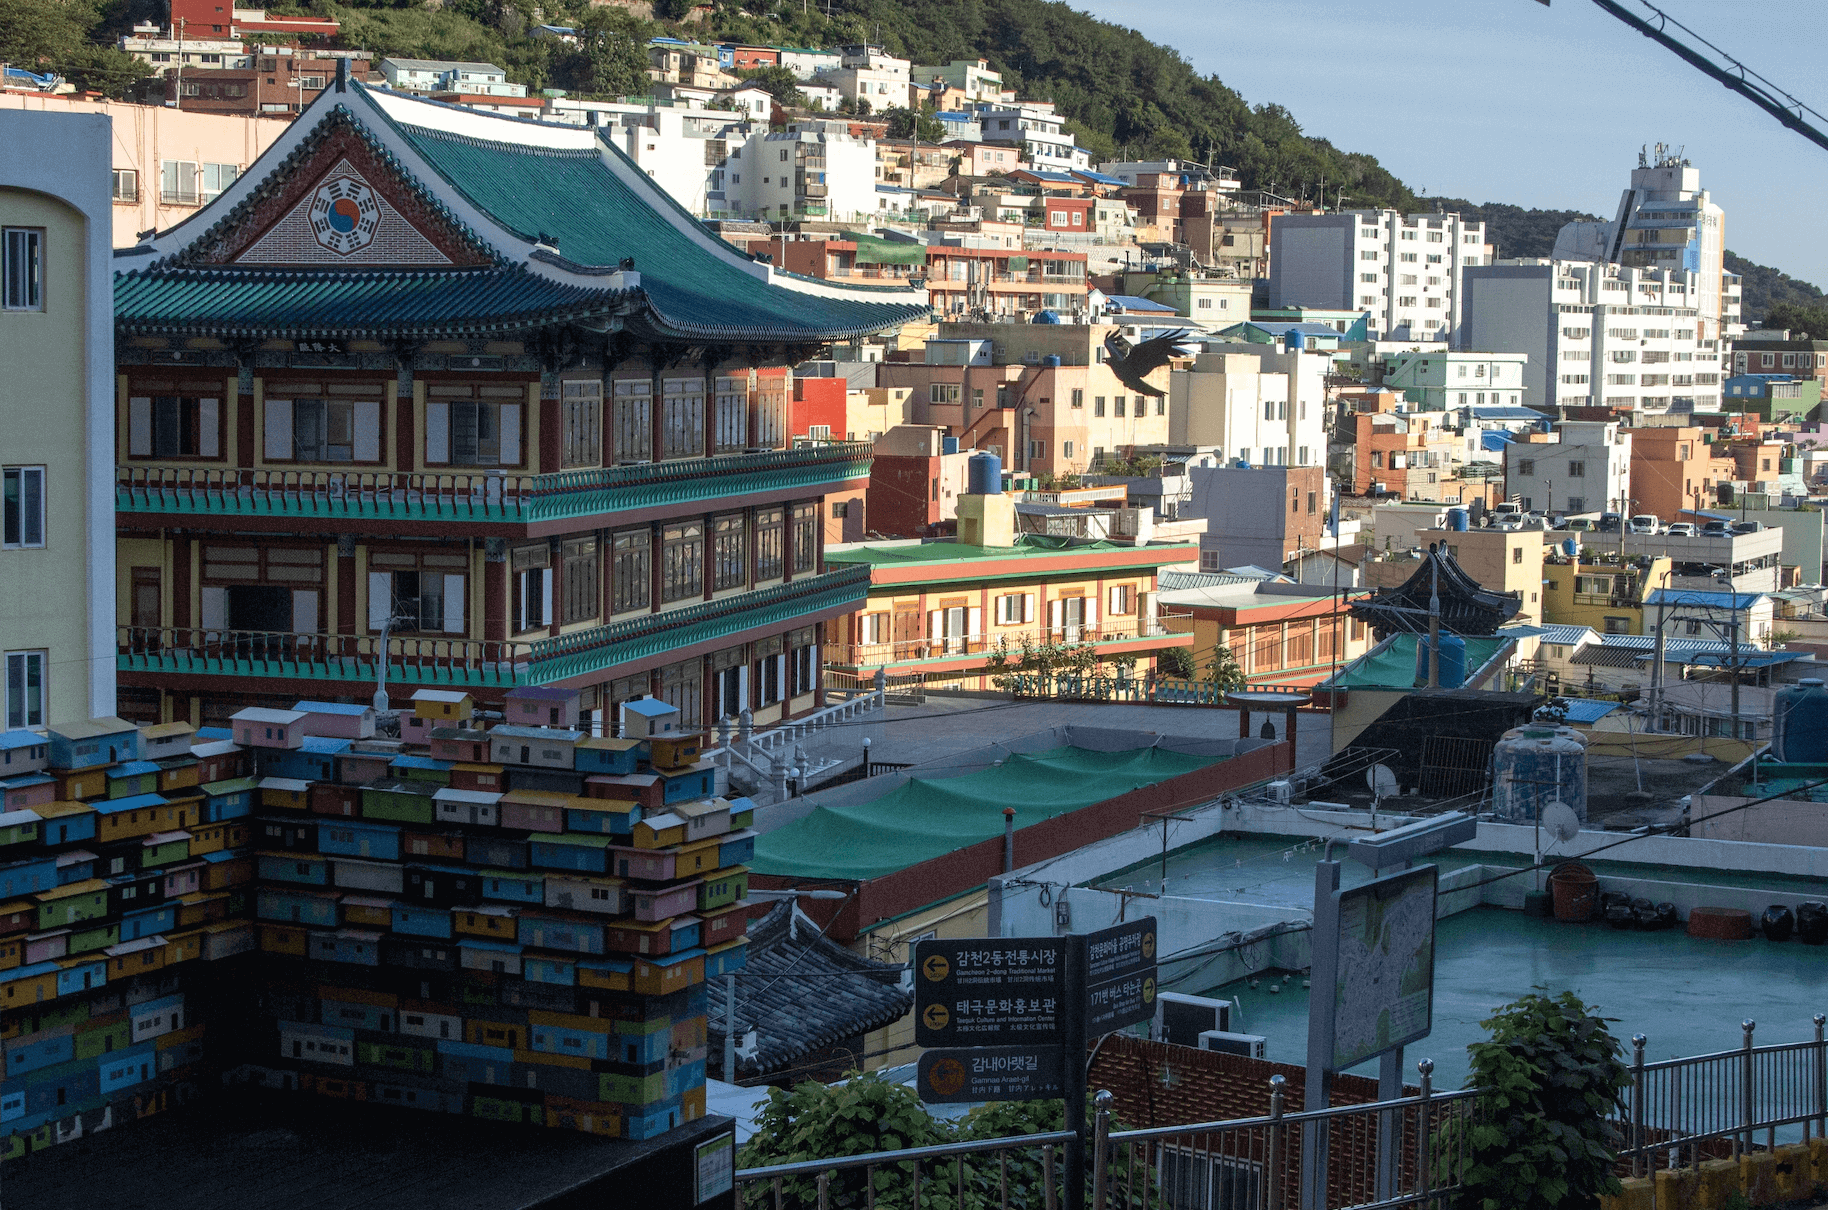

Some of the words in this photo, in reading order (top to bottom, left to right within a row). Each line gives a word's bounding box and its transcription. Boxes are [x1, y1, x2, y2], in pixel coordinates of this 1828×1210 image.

[956, 949, 1057, 967] 감천2동전통시장
[1091, 988, 1108, 1006] 171번
[1109, 985, 1122, 1001] 버스
[956, 998, 1056, 1015] 태극문화홍보관
[972, 1055, 1038, 1072] 감내아랫길
